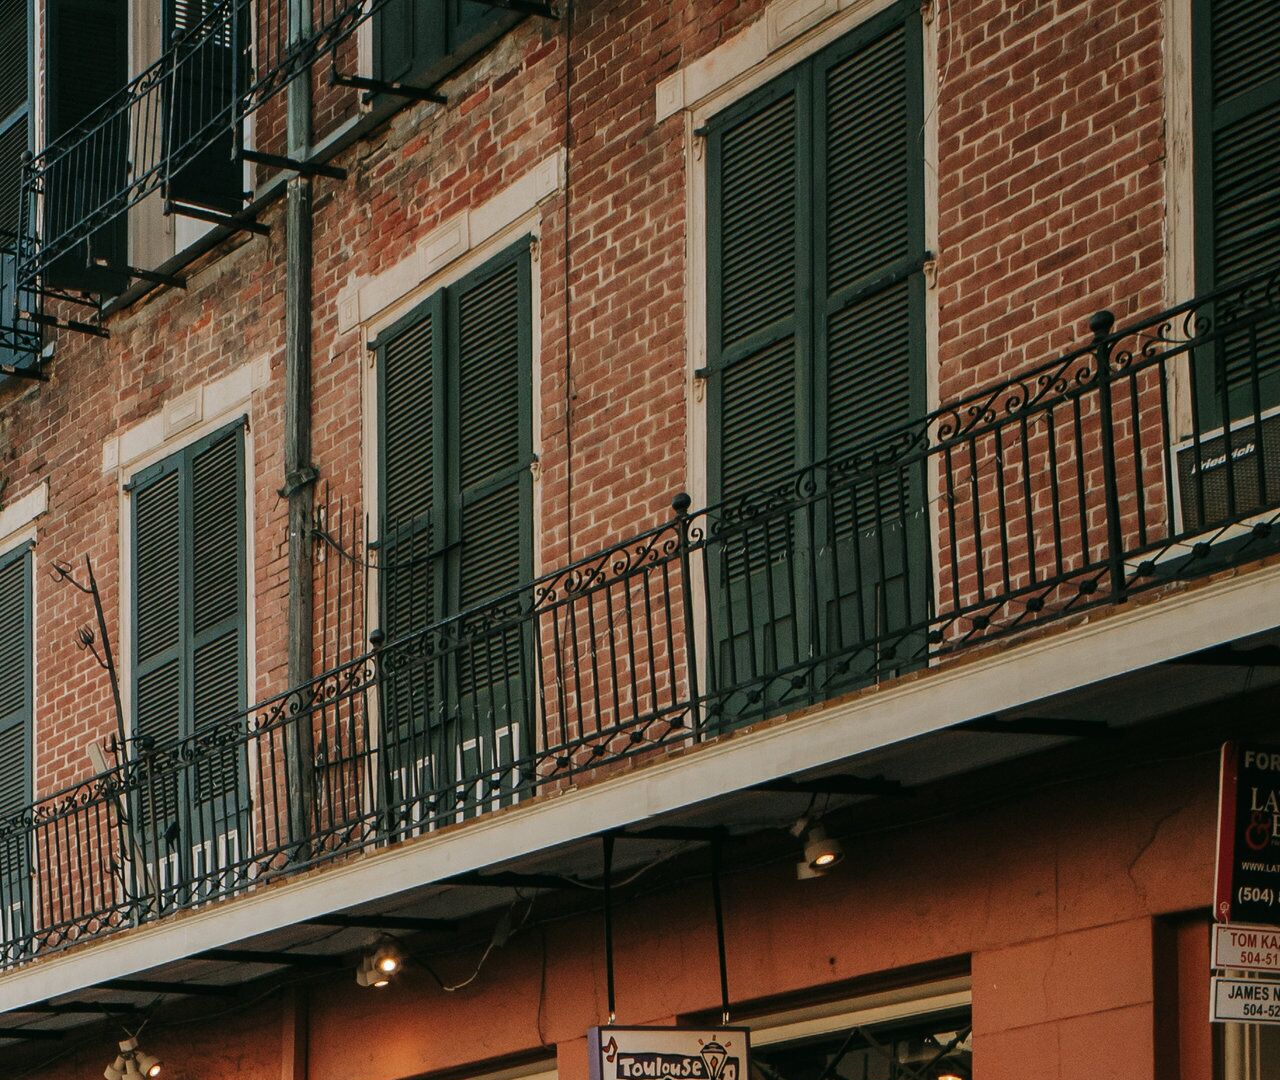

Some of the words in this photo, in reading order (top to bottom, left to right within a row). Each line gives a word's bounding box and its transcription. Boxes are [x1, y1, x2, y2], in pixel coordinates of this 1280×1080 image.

[1238, 887, 1274, 906] (504)
[1231, 932, 1257, 947] TOM
[1228, 985, 1269, 1001] JAMES
[619, 1057, 703, 1077] Toulouse
